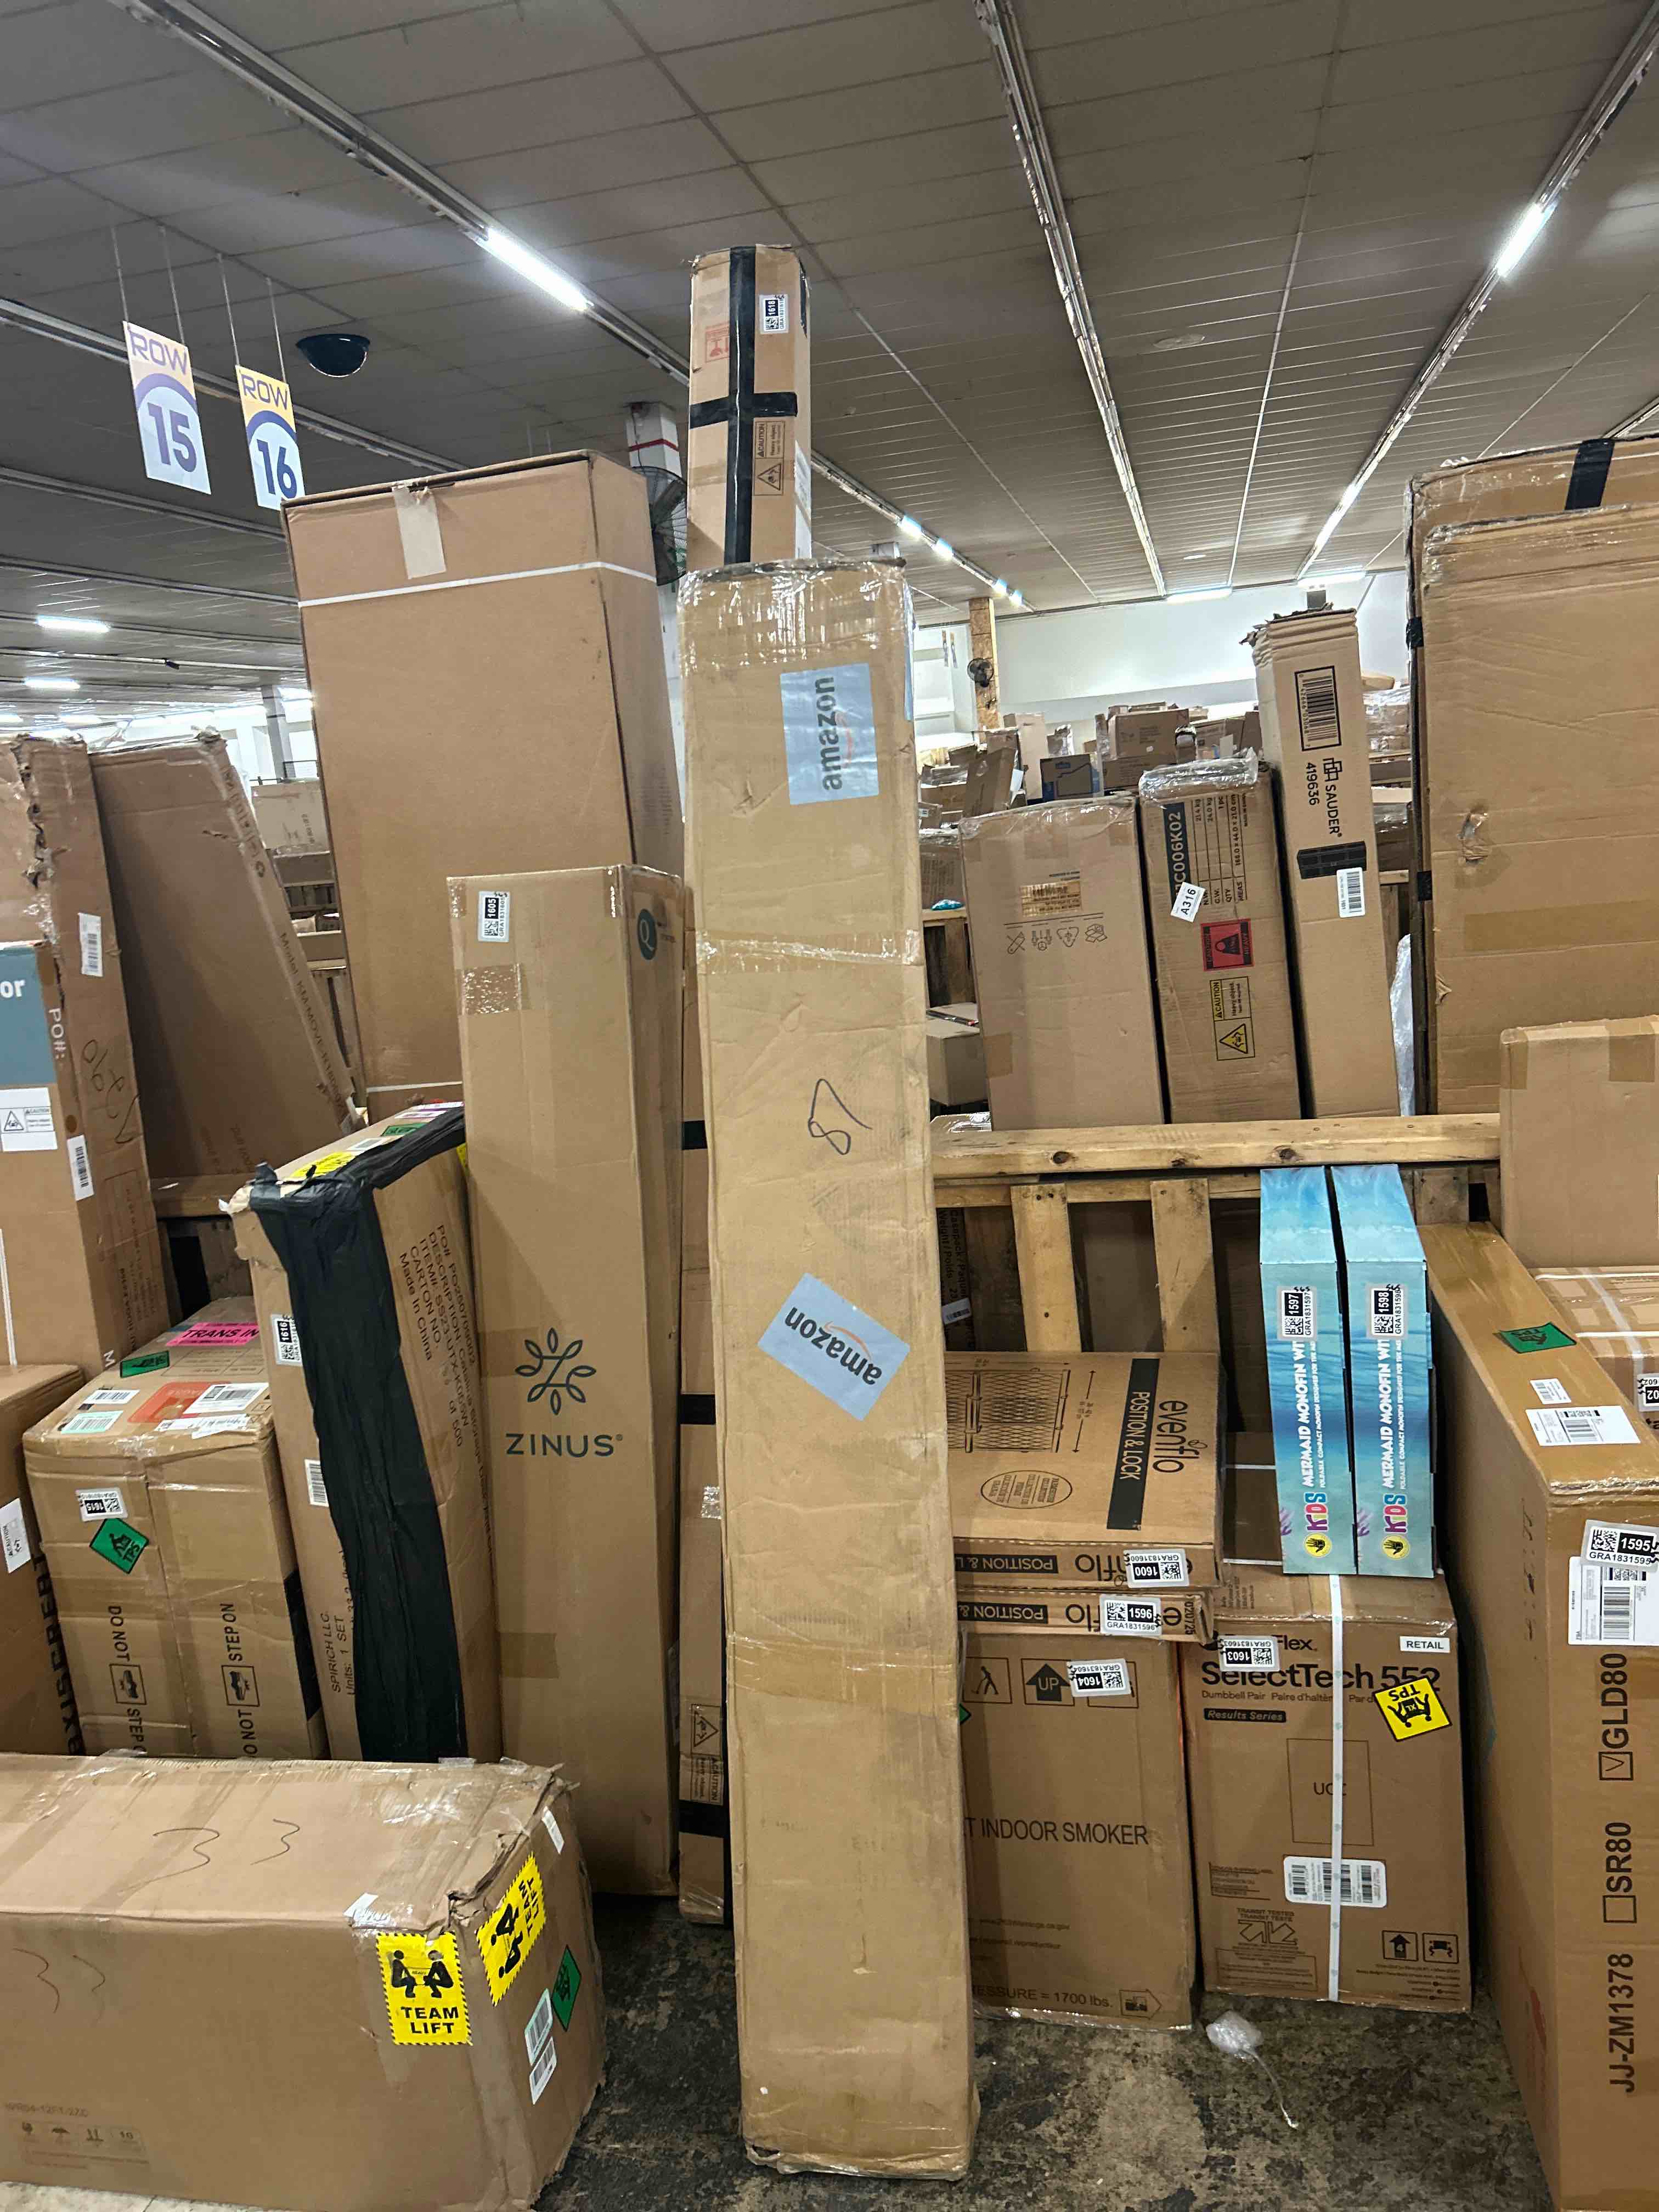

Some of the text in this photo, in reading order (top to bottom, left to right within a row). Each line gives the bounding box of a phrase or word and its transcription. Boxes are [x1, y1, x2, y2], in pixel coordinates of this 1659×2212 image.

[128, 328, 188, 375] ROW
[240, 374, 288, 410] ROW
[148, 403, 197, 472] 15
[256, 439, 297, 498] 16
[815, 676, 843, 790] amazon
[1306, 762, 1320, 806] 419636
[487, 898, 497, 918] 1605
[1181, 888, 1197, 916] A316
[1214, 981, 1222, 1013] CAUTION
[410, 1246, 435, 1316] CARTON
[399, 1252, 415, 1296] Made
[417, 1316, 432, 1361] China
[1288, 1294, 1300, 1315] 1597
[1378, 1291, 1390, 1313] 1598
[182, 1329, 241, 1338] TRANS
[280, 1322, 289, 1342] 1616
[784, 1306, 883, 1387] amazon
[1294, 1364, 1310, 1424] MONOFIN
[1378, 1363, 1393, 1425] MONOFIN
[1119, 1391, 1150, 1480] POSITION & LOCK
[1152, 1400, 1199, 1474] evenflo
[1298, 1425, 1314, 1487] MERMAID
[1380, 1426, 1395, 1489] MERMAID
[86, 1502, 105, 1511] 1615
[1304, 1492, 1328, 1533] KIDS
[1383, 1493, 1408, 1534] KIDS
[1130, 1554, 1180, 1562] GRA1831600
[1621, 1537, 1651, 1552] 1595
[969, 1559, 978, 1569] &
[983, 1557, 1053, 1571] POSITION
[1135, 1565, 1158, 1577] 1600
[1589, 1551, 1652, 1566] GRA1831595
[220, 1602, 237, 1625] ON
[974, 1605, 1044, 1621] POSITION
[1107, 1622, 1155, 1631] GRA1831596
[1128, 1607, 1153, 1620] 1596
[334, 1615, 347, 1642] SET
[229, 1630, 244, 1661] STEP
[1227, 1651, 1250, 1661] 1603
[1406, 1640, 1444, 1650] RETAIL
[109, 1606, 144, 1746] DO NOT STEP
[325, 1640, 341, 1693] SPIRICH
[1038, 1678, 1059, 1690] UP
[1077, 1675, 1101, 1688] 1604
[1389, 1684, 1421, 1702] TPS
[1202, 1690, 1246, 1700] Dumbbell
[1247, 1691, 1266, 1701] Pair
[1271, 1692, 1296, 1701] Paire
[1601, 1653, 1630, 1750] GLD80
[238, 1709, 257, 1740] NOT
[1207, 1709, 1284, 1722] Results Series
[981, 1819, 1058, 1842] INDOOR
[1063, 1822, 1149, 1846] SMOKER
[1605, 1822, 1633, 1894] SR80
[400, 2006, 460, 2020] TEAM
[1053, 1991, 1087, 2006] 1700
[1090, 1993, 1113, 2008] lbs.
[410, 2022, 454, 2035] LIFT
[1608, 1953, 1635, 2094] JJ-ZM1378
